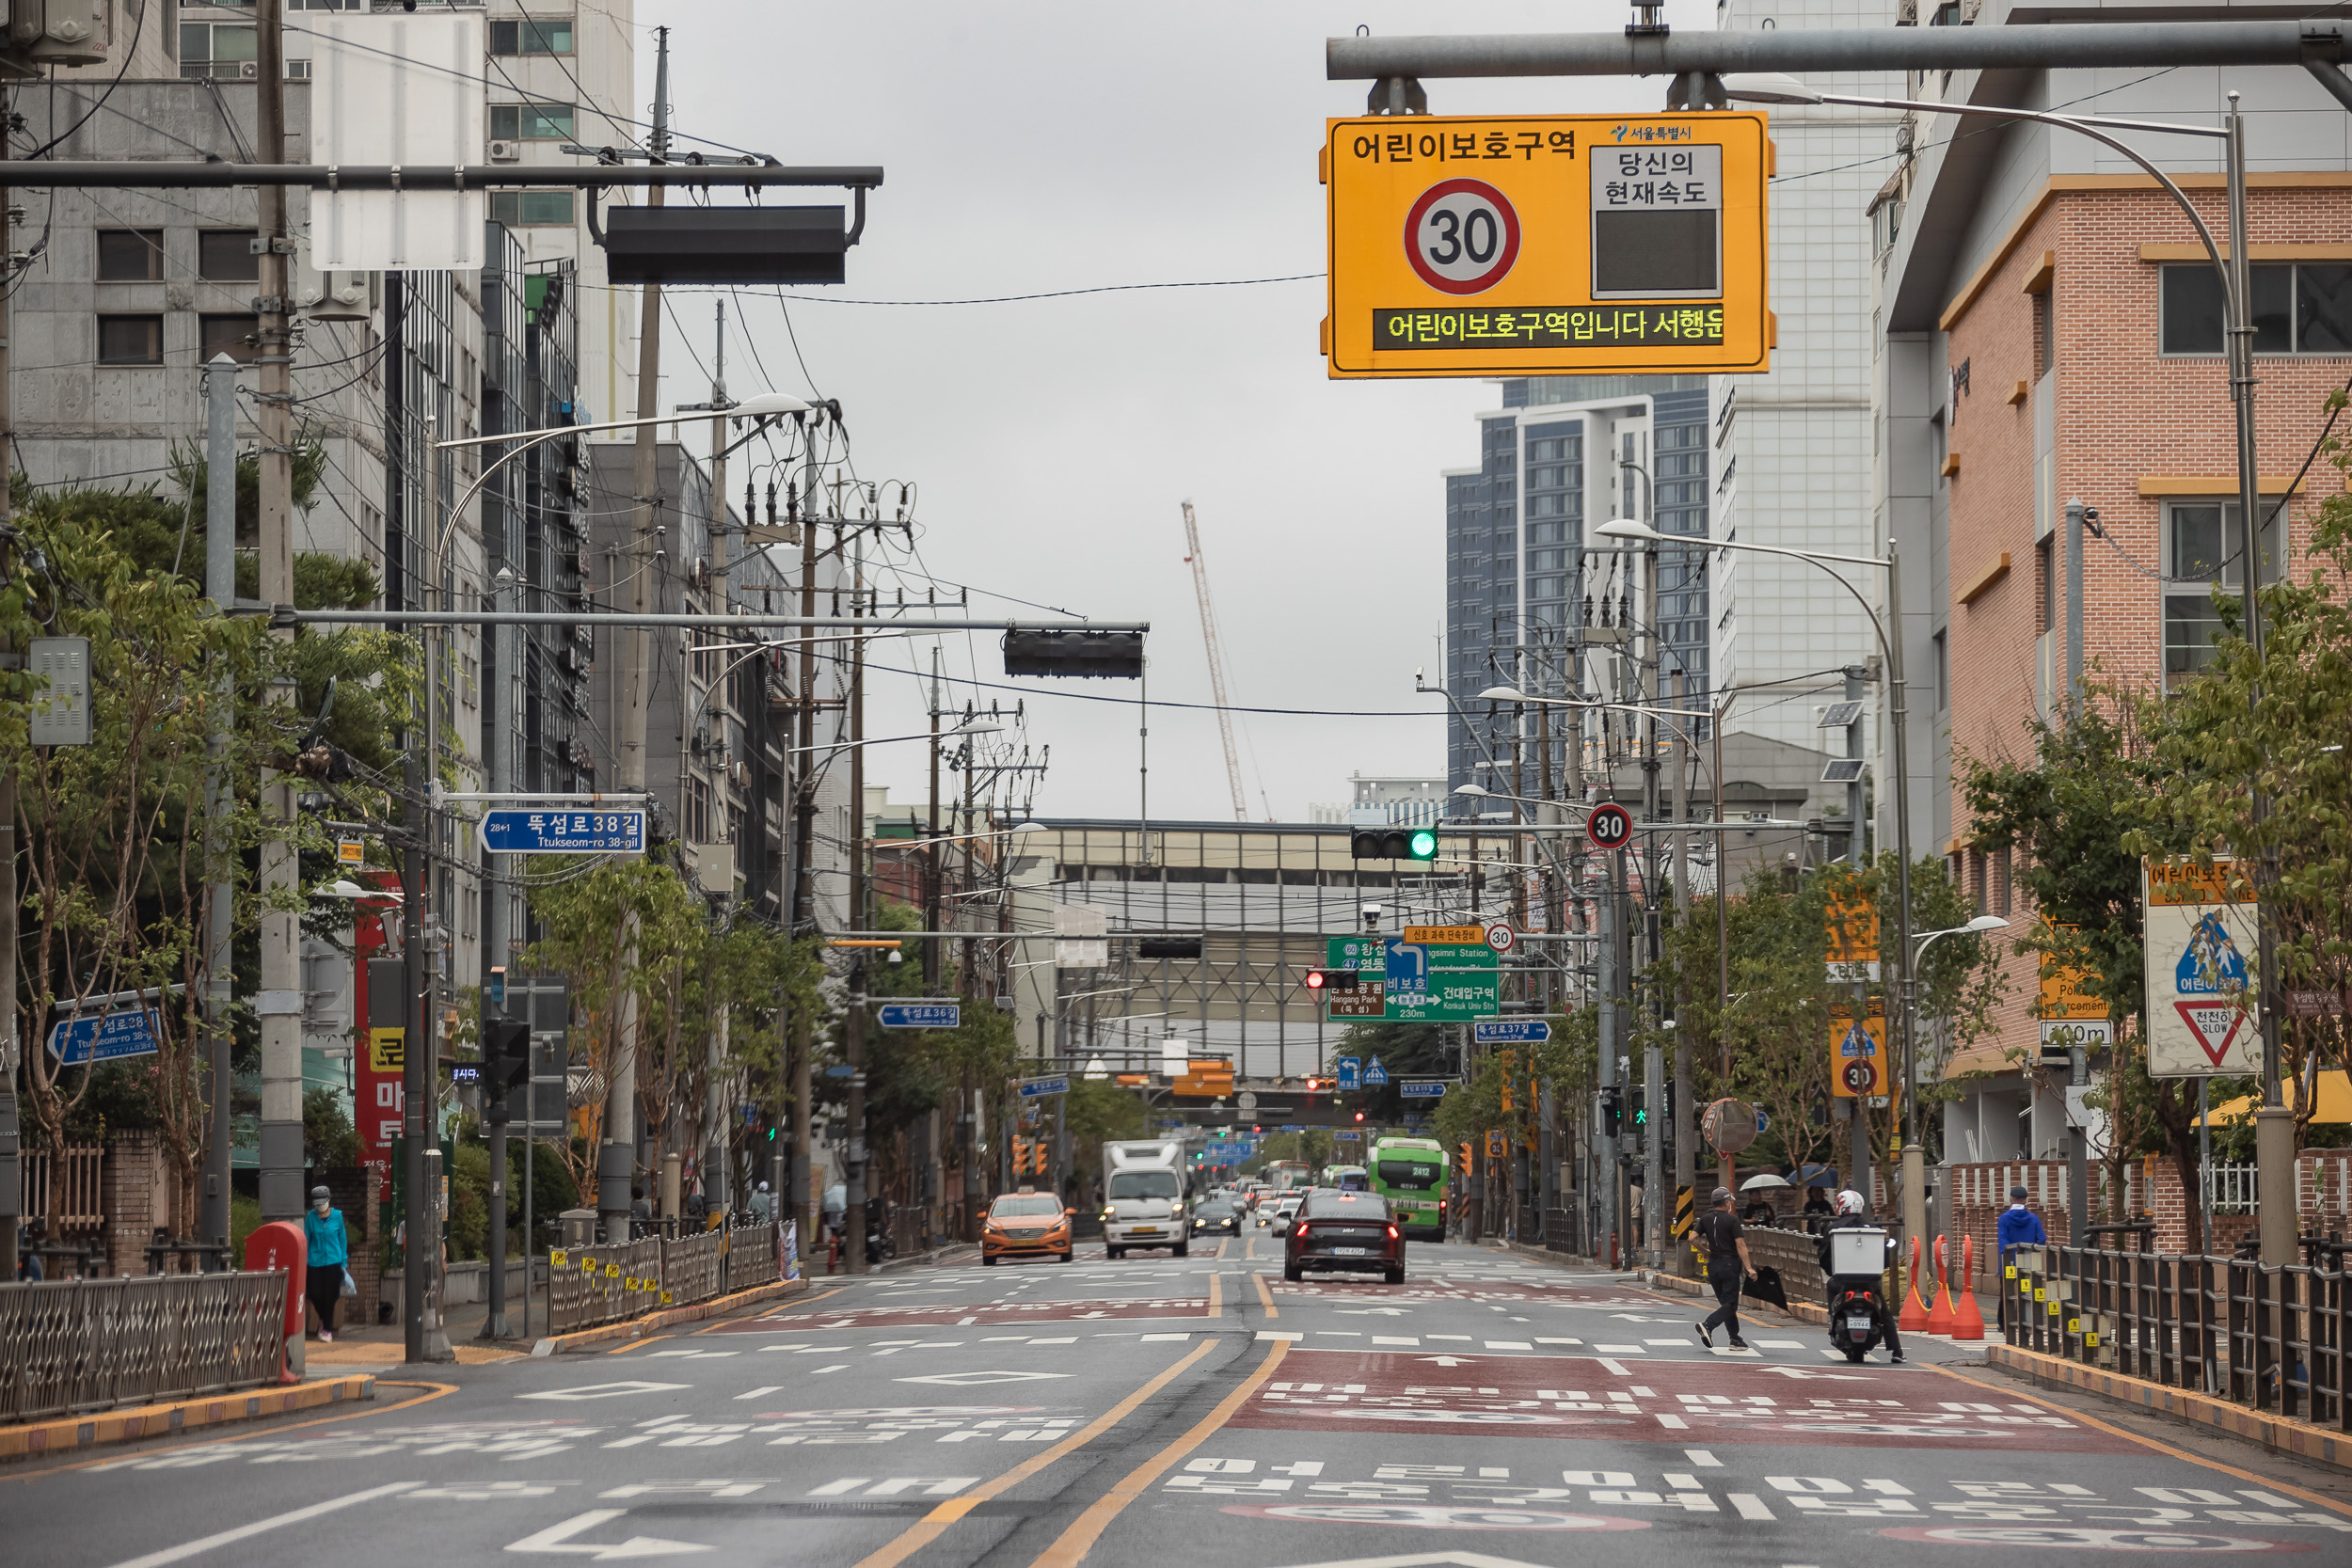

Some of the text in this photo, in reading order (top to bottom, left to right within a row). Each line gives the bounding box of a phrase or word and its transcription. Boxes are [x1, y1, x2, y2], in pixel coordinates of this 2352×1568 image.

[1630, 124, 1692, 142] 서울특별시
[1352, 130, 1576, 163] 어린이보호구역
[1618, 150, 1693, 177] 당신의
[1606, 180, 1708, 205] 현재속도
[1428, 208, 1498, 264] 30
[1389, 311, 1646, 343] 어린이보호구역입니다
[527, 815, 638, 835] 뚝섬로38길
[1597, 816, 1623, 837] 30
[537, 836, 638, 849] Ttukseom-ro 38-gil
[1413, 930, 1428, 941] 신호
[1447, 929, 1475, 941] 단속장비
[1492, 931, 1509, 943] 30
[1459, 948, 1488, 958] Station
[1344, 959, 1356, 969] 47
[1387, 976, 1426, 990] 비보호
[1443, 987, 1494, 1000] 건대입구역
[1330, 995, 1377, 1005] Hangang Park
[1468, 1002, 1482, 1010] Univ
[1483, 1002, 1495, 1010] Stn
[2044, 1001, 2107, 1011] ercement
[901, 1007, 956, 1019] 뚝섬로36길
[1399, 1009, 1425, 1018] 230m
[2196, 1011, 2231, 1023] 천천히
[1478, 1023, 1530, 1035] 뚝섬로37길
[2052, 1025, 2105, 1041] 0m
[2201, 1023, 2228, 1034] SLOW
[1412, 1166, 1430, 1176] 2412
